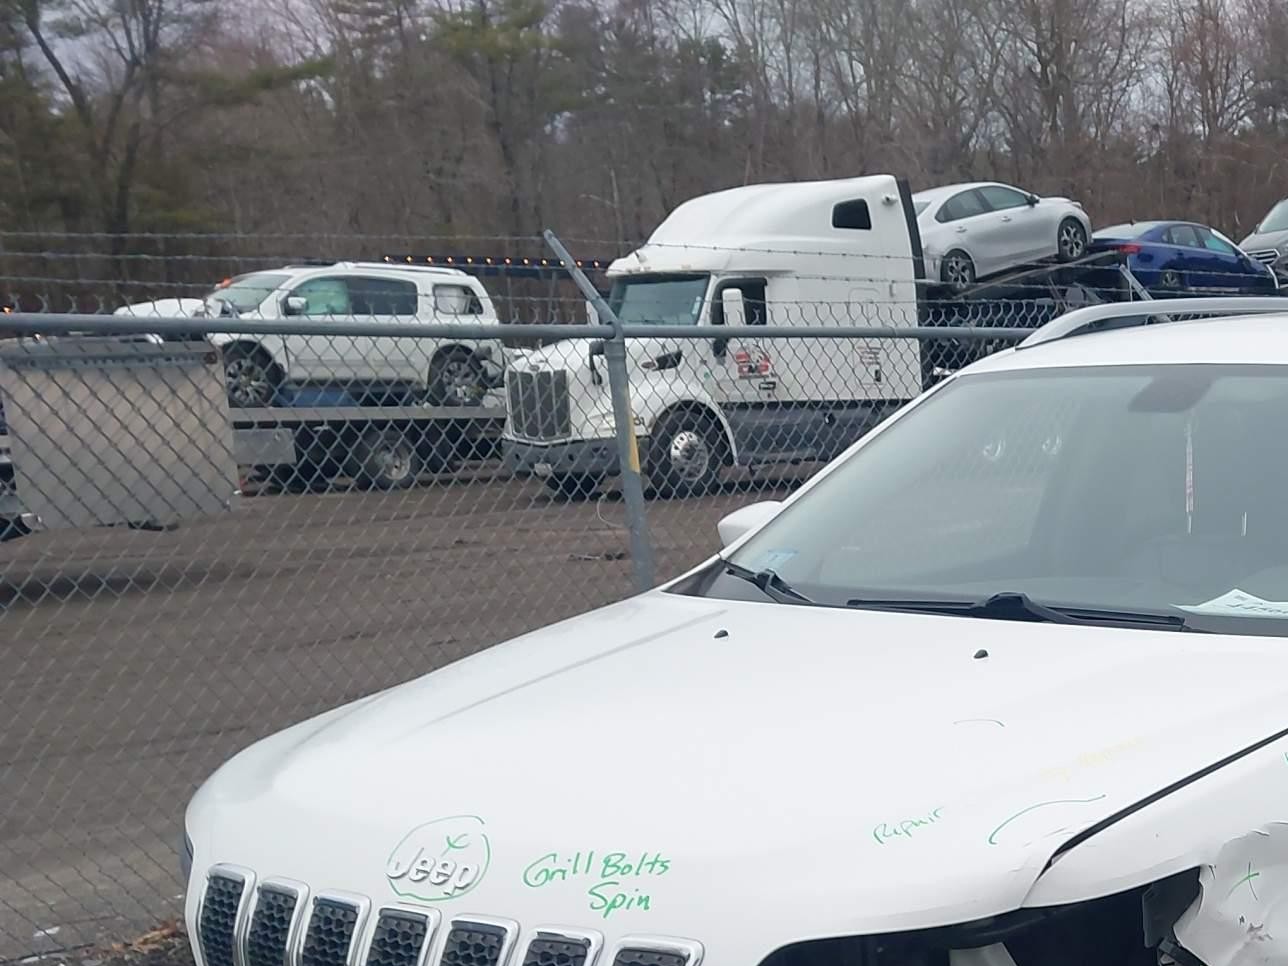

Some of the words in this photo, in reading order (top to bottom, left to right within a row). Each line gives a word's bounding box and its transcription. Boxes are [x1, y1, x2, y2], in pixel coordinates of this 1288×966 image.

[384, 847, 479, 897] Jeep
[600, 852, 671, 879] Bolts
[588, 881, 650, 918] Spin
